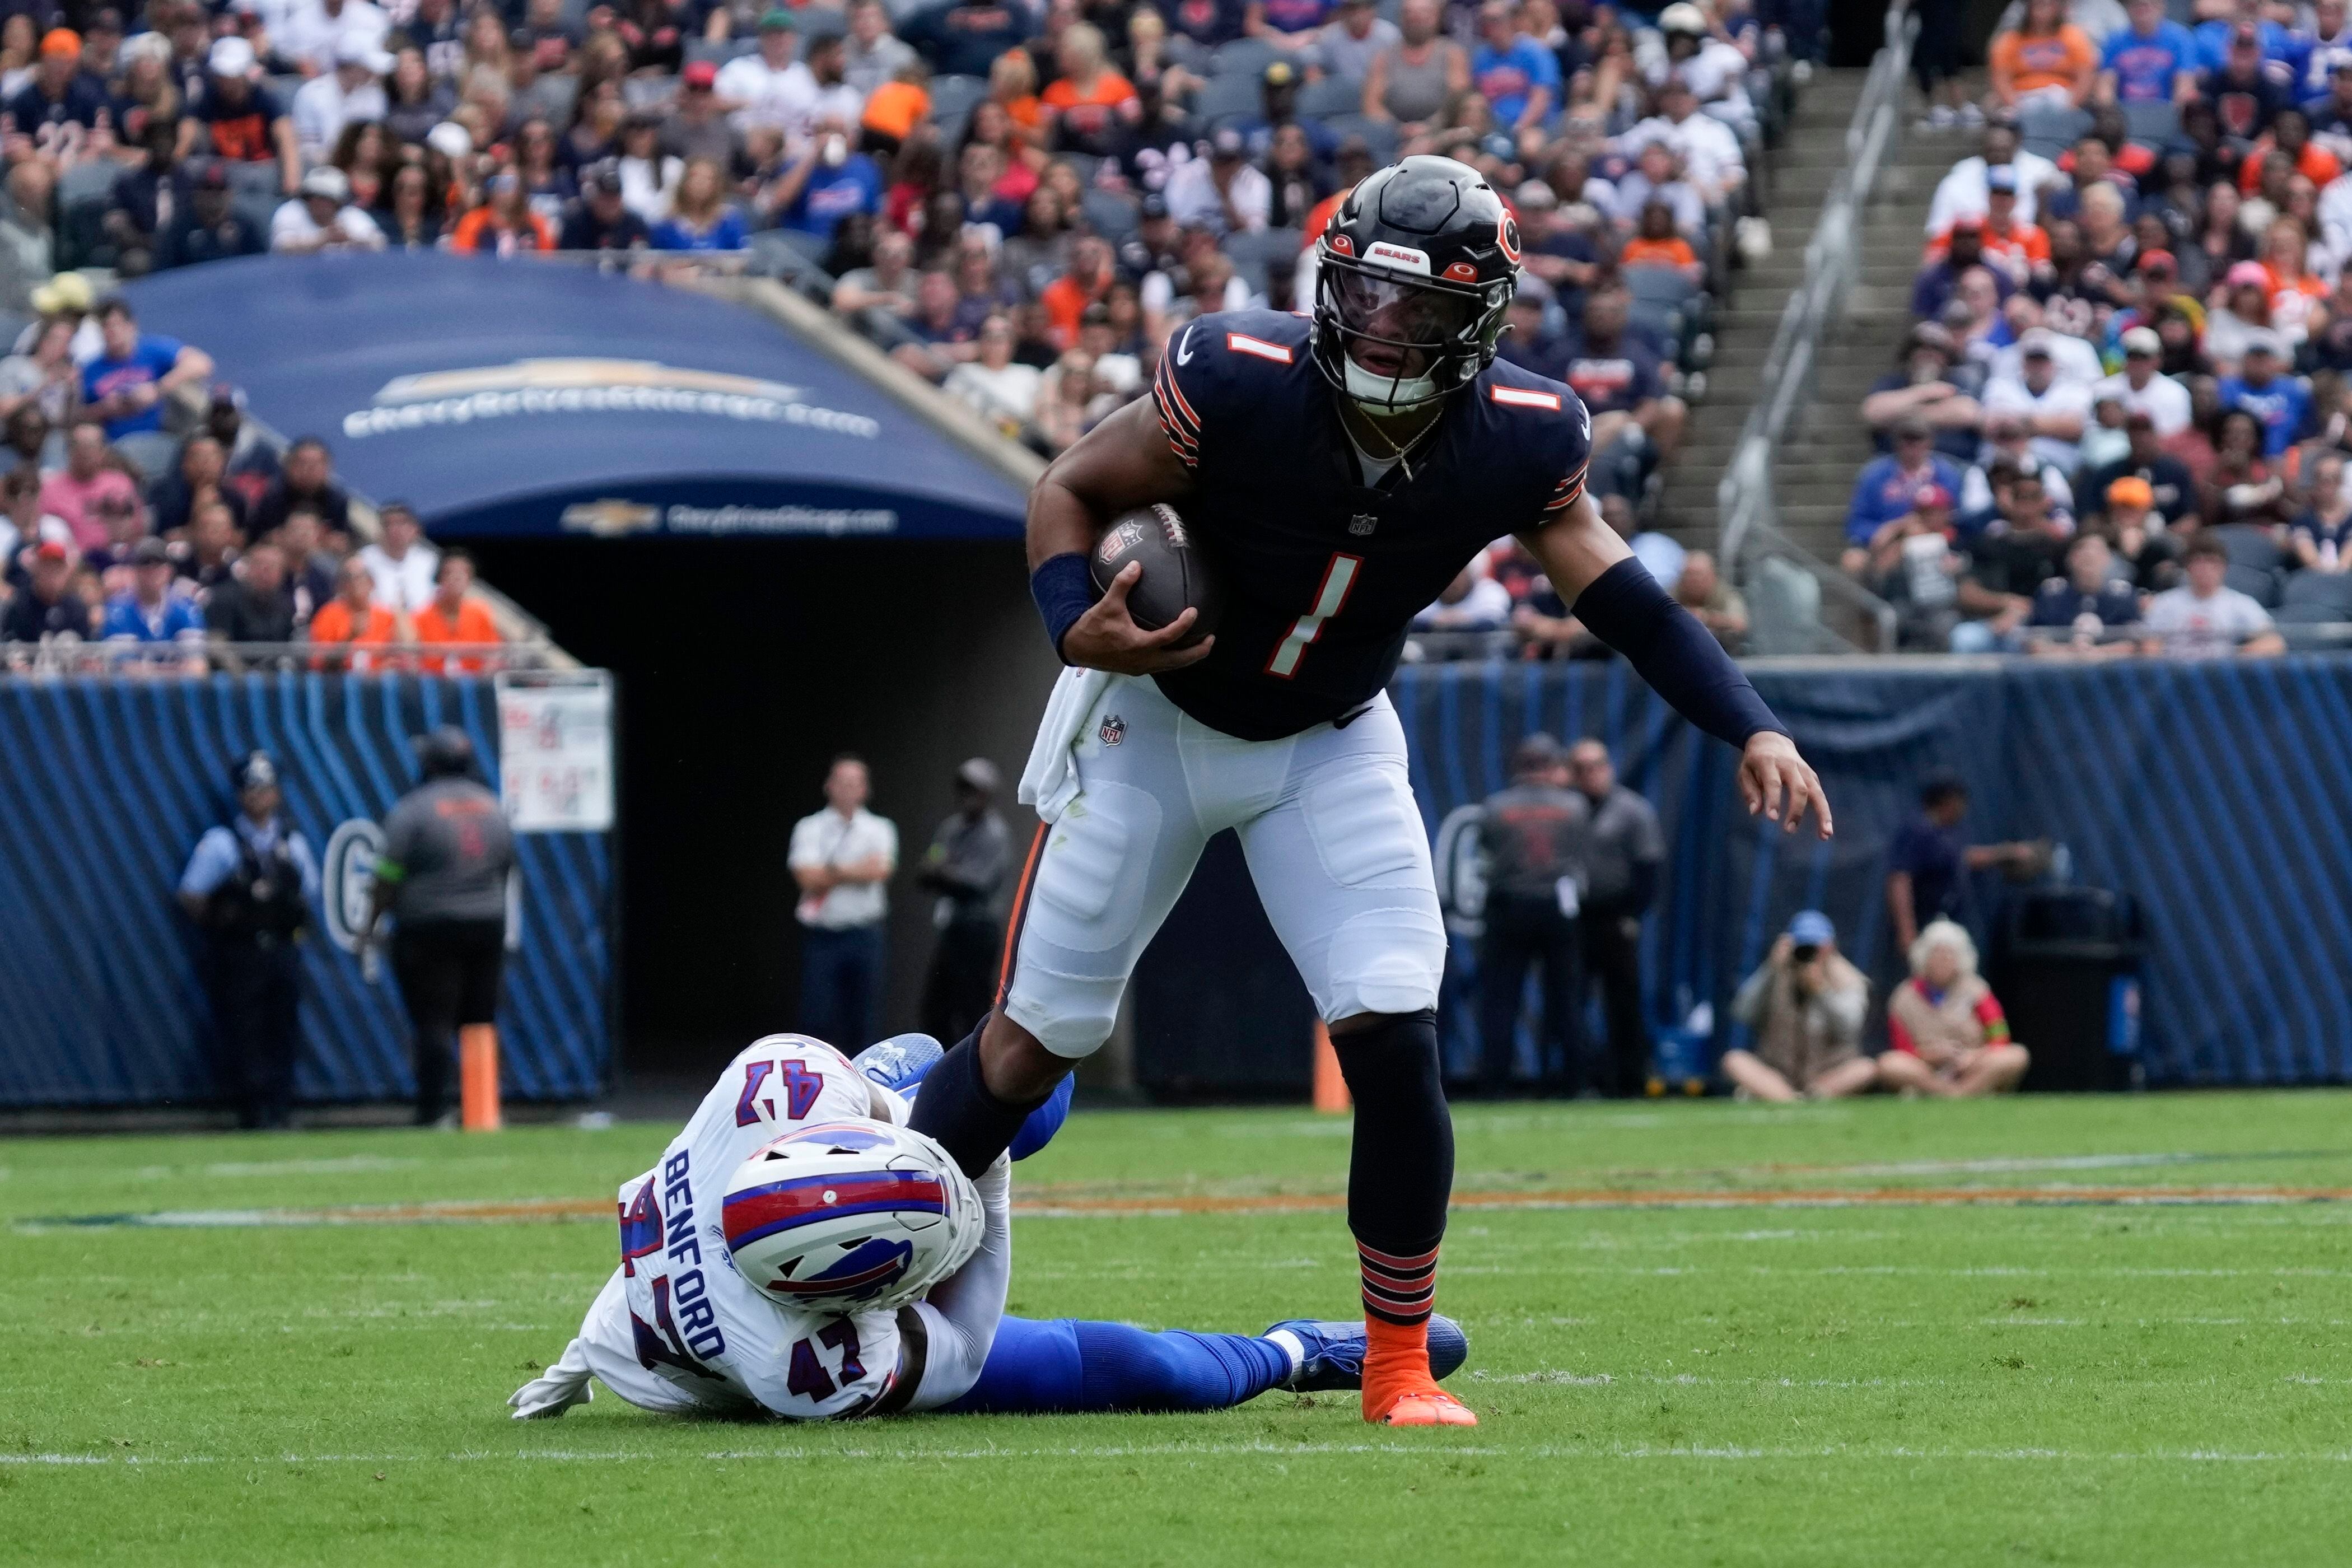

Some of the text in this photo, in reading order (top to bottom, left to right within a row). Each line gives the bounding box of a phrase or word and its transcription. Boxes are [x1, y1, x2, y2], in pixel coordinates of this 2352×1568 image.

[1374, 247, 1420, 263] BEARS
[1227, 333, 1293, 363] 1
[1491, 385, 1561, 410] 1
[1264, 551, 1365, 680] 1
[1102, 727, 1119, 742] NFL
[665, 1149, 726, 1361] BENFORD
[787, 1315, 867, 1403] 47
